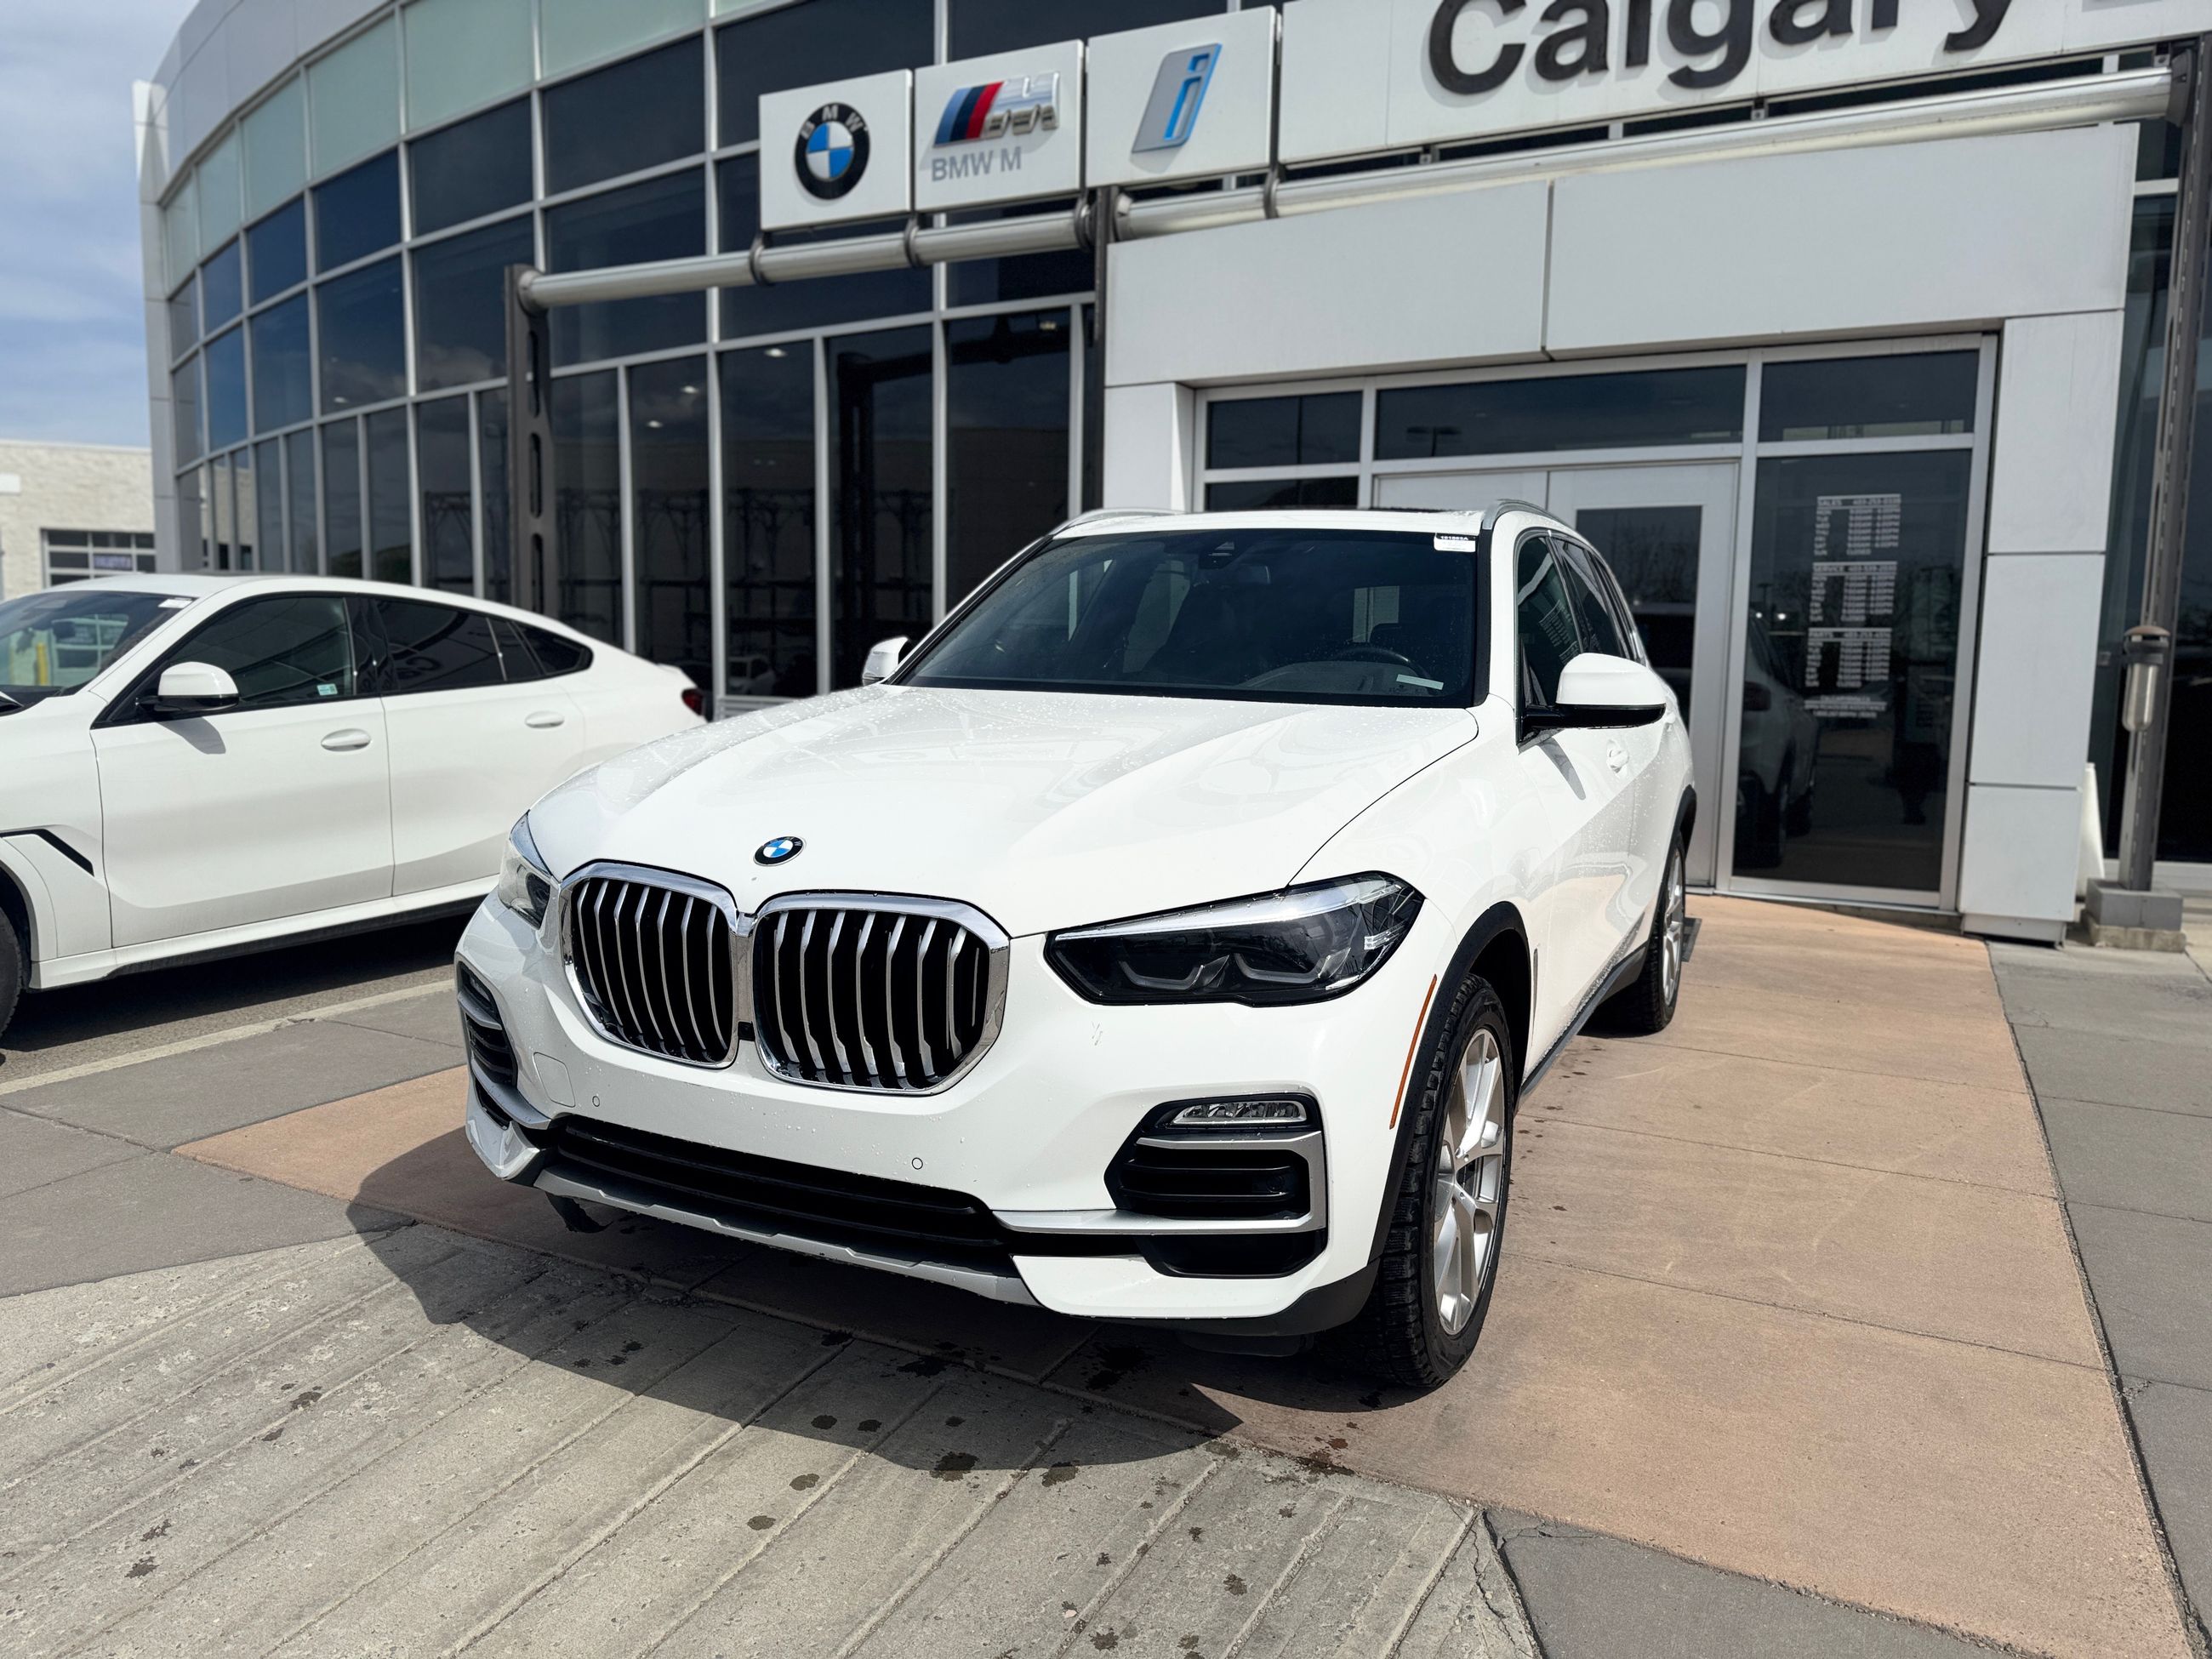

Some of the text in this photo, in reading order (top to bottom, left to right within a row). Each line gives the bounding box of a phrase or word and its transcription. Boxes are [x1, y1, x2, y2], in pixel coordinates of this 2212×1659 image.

[800, 104, 864, 140] BMW
[932, 146, 1021, 182] BMW M
